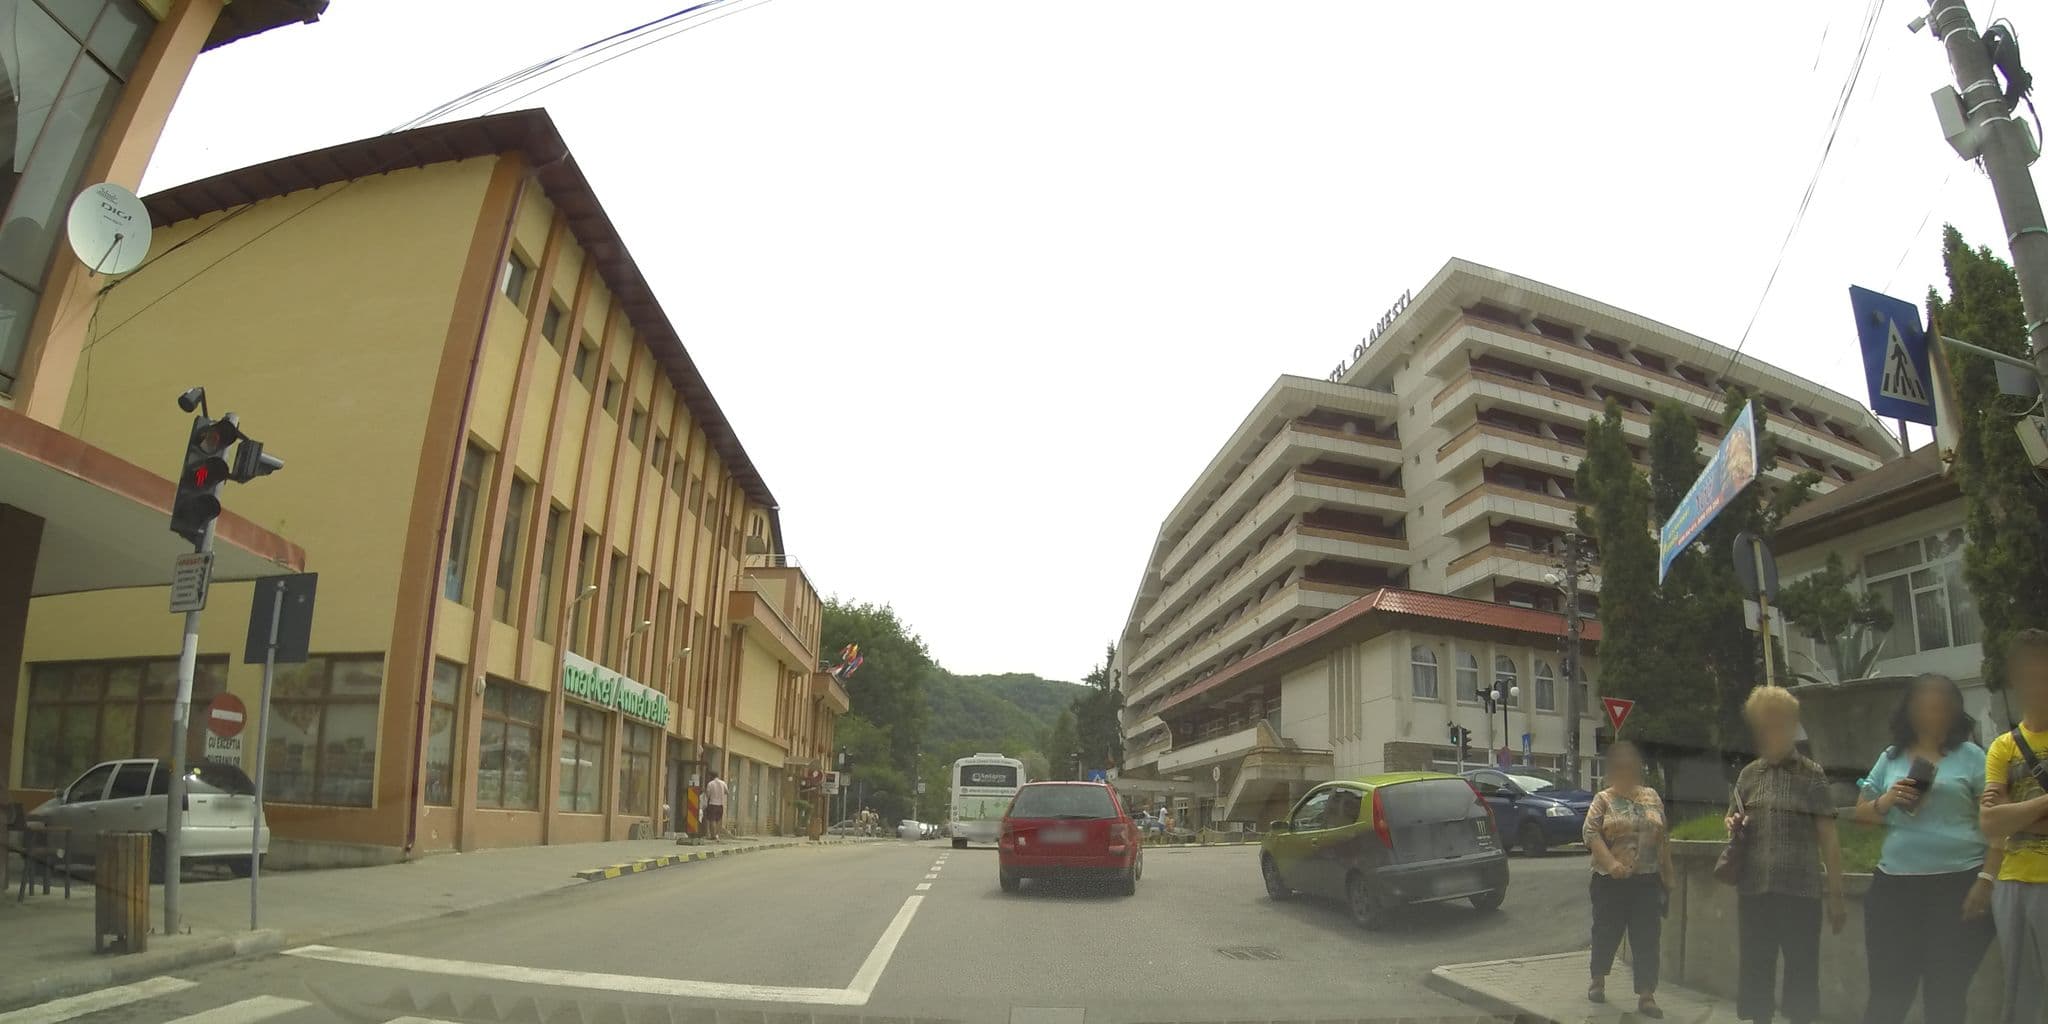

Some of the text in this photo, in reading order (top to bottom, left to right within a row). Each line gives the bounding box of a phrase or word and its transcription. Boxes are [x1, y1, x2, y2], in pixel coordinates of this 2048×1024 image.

[101, 202, 132, 221] DIGI
[1329, 359, 1346, 384] TEL
[564, 664, 670, 726] market Annabella
[208, 736, 216, 748] CU
